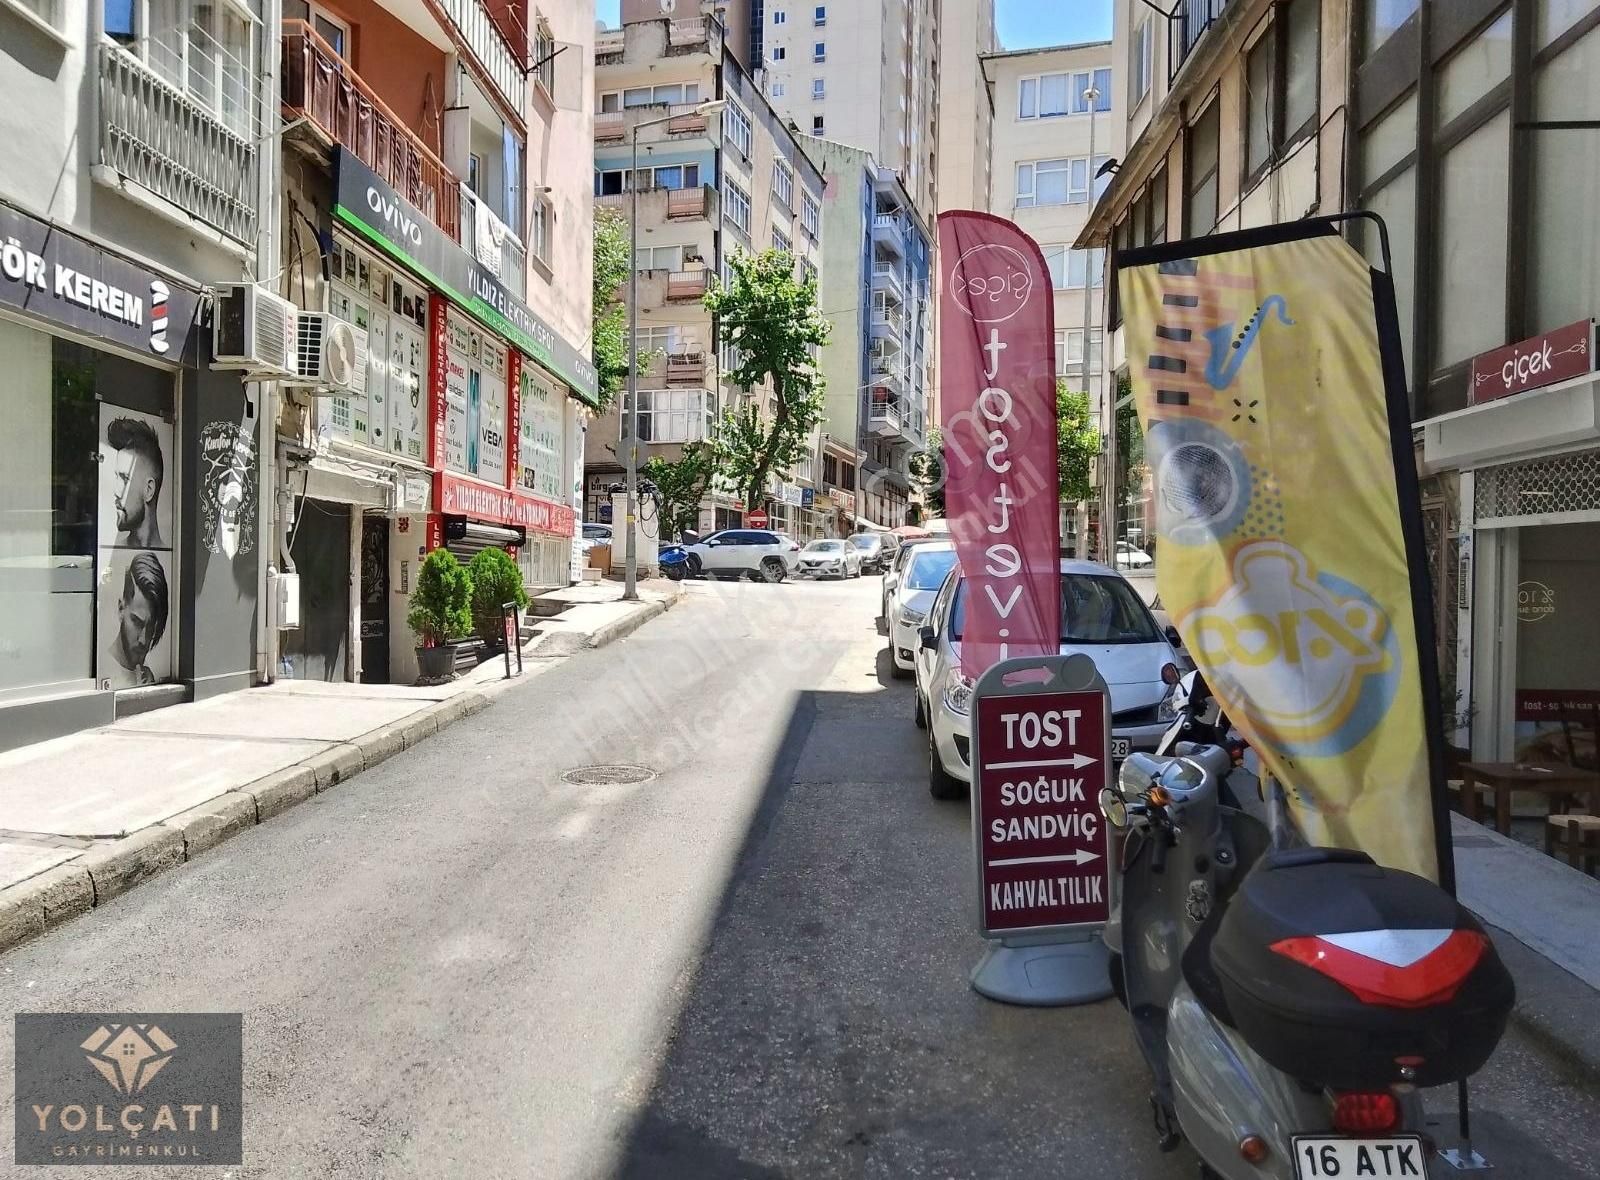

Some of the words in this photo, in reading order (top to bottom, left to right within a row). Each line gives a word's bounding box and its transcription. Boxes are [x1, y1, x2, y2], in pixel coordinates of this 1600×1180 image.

[366, 186, 422, 246] ovivo
[0, 235, 48, 290] ÖR
[54, 262, 144, 328] KEREM
[467, 264, 497, 307] YILDIZ
[1501, 339, 1553, 389] çiçek
[481, 426, 504, 449] VEGA
[228, 508, 237, 518] OF
[433, 522, 441, 548] LED
[1000, 709, 1082, 750] TOST
[1000, 774, 1086, 807] SOĞUK
[990, 807, 1098, 844] SANDVİÇ
[990, 875, 1103, 911] KAHVALTILIK
[1304, 1144, 1341, 1177] 16
[1356, 1144, 1419, 1177] ATK
